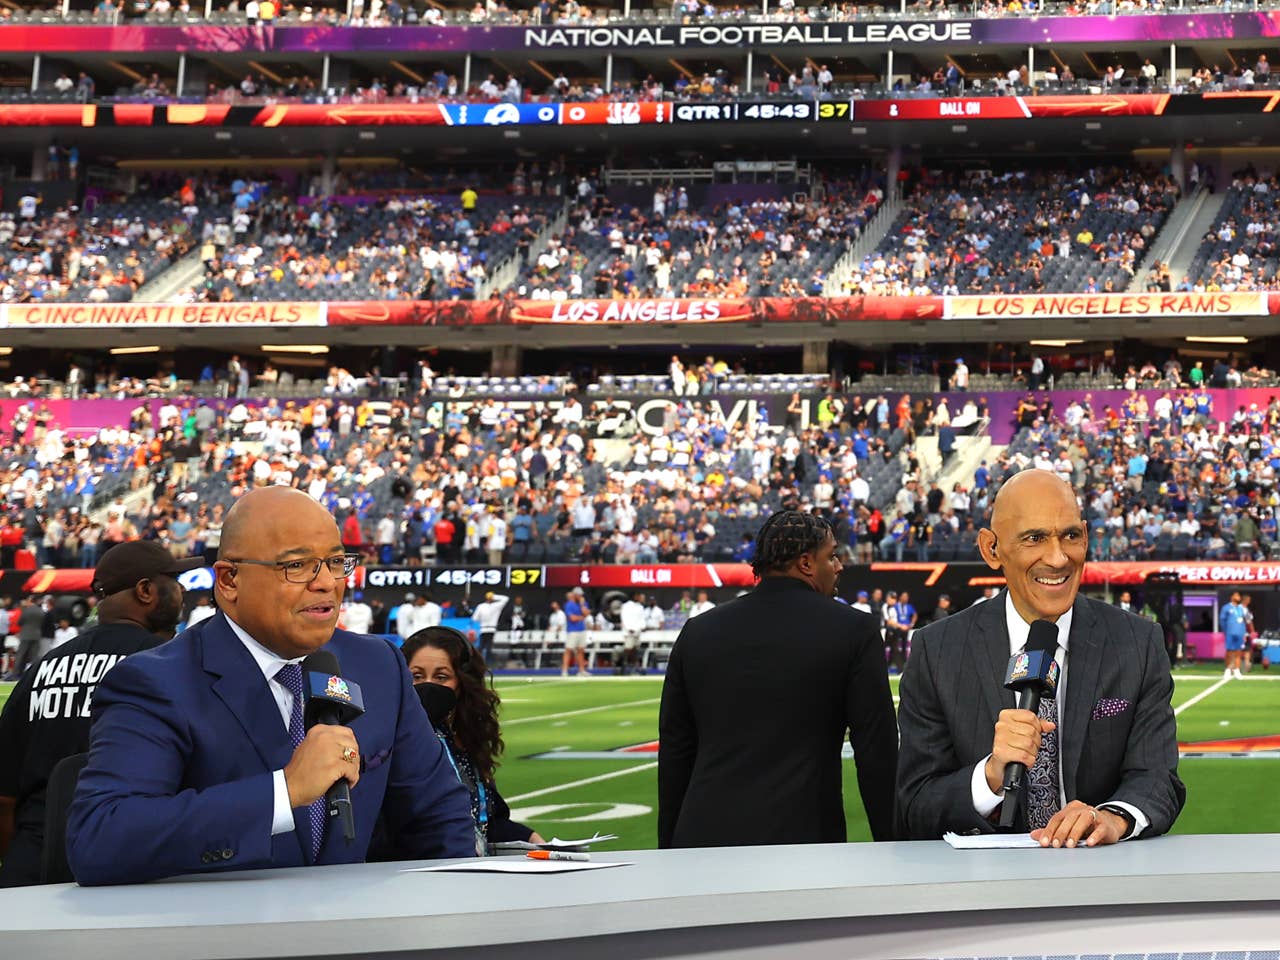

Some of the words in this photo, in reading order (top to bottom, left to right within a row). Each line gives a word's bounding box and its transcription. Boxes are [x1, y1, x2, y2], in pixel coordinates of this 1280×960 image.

[524, 26, 675, 47] NATIONAL
[679, 25, 843, 45] FOOTBALL
[847, 23, 972, 43] LEAGUE
[538, 106, 555, 121] 0
[569, 106, 586, 121] 0
[677, 105, 722, 120] QTR
[723, 105, 731, 119] 1
[744, 104, 810, 119] 45:43
[820, 103, 849, 118] 37
[940, 103, 965, 115] BALL
[966, 103, 981, 115] ON
[551, 301, 600, 322] LOS
[602, 301, 721, 321] ANGELES
[975, 298, 1025, 316] LOS
[1032, 296, 1151, 315] ANGELES
[1159, 294, 1232, 313] RAMS
[25, 306, 175, 324] CINCINNATI
[182, 305, 302, 323] BENGALS
[368, 570, 413, 586] QTR
[414, 570, 423, 585] 1
[436, 569, 502, 585] 45:43
[511, 569, 540, 585] 37
[630, 569, 655, 583] BALL
[656, 569, 671, 583] ON
[1210, 566, 1255, 580] BOWL
[29, 686, 96, 722] MOTE
